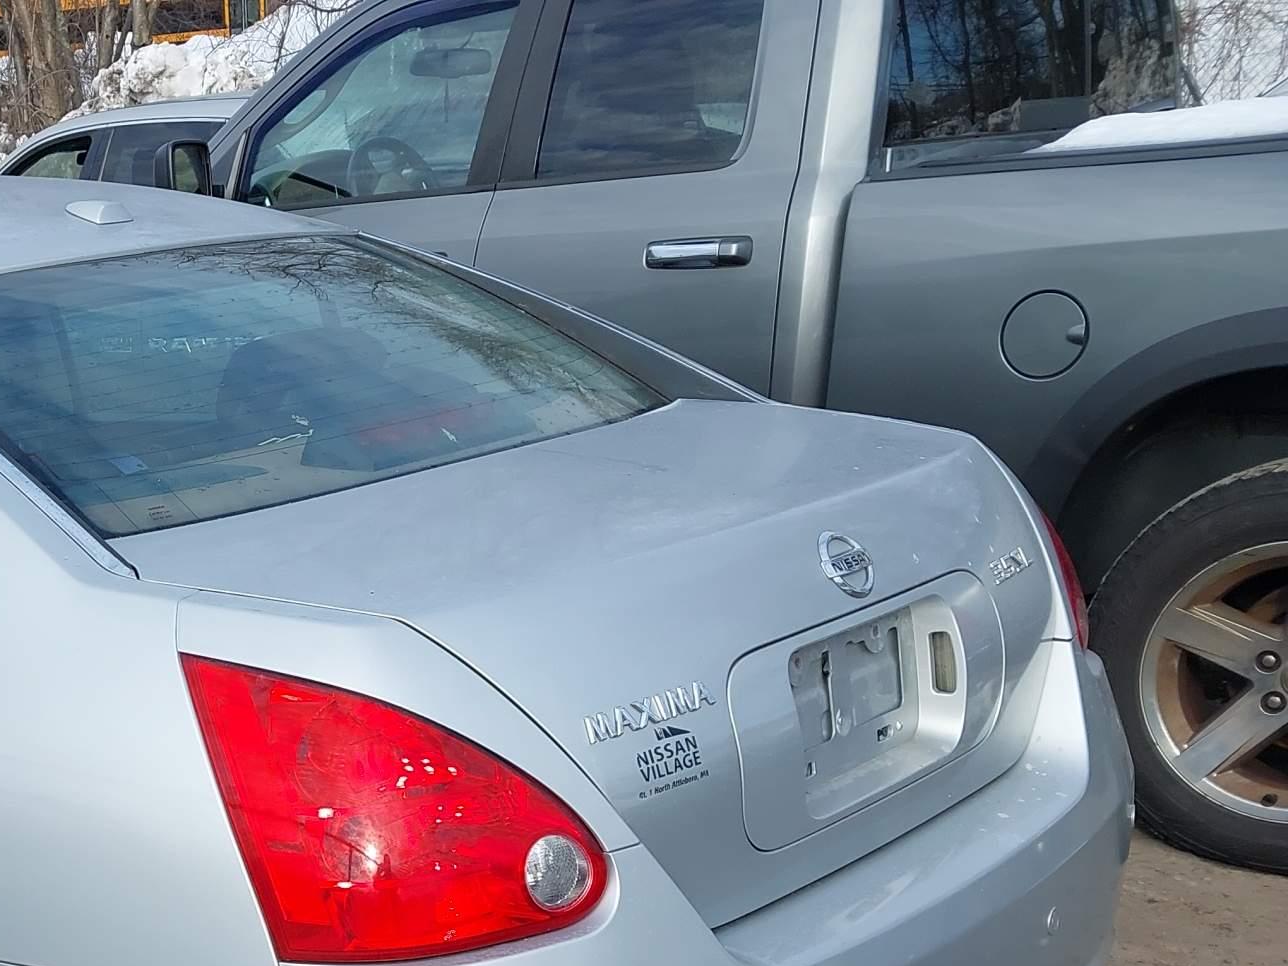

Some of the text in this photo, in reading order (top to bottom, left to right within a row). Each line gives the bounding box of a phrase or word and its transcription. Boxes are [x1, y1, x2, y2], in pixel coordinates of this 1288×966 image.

[583, 681, 717, 745] MAXIMA
[636, 735, 698, 768] NISSAN
[639, 750, 702, 782] VILLAGE
[654, 783, 671, 794] North
